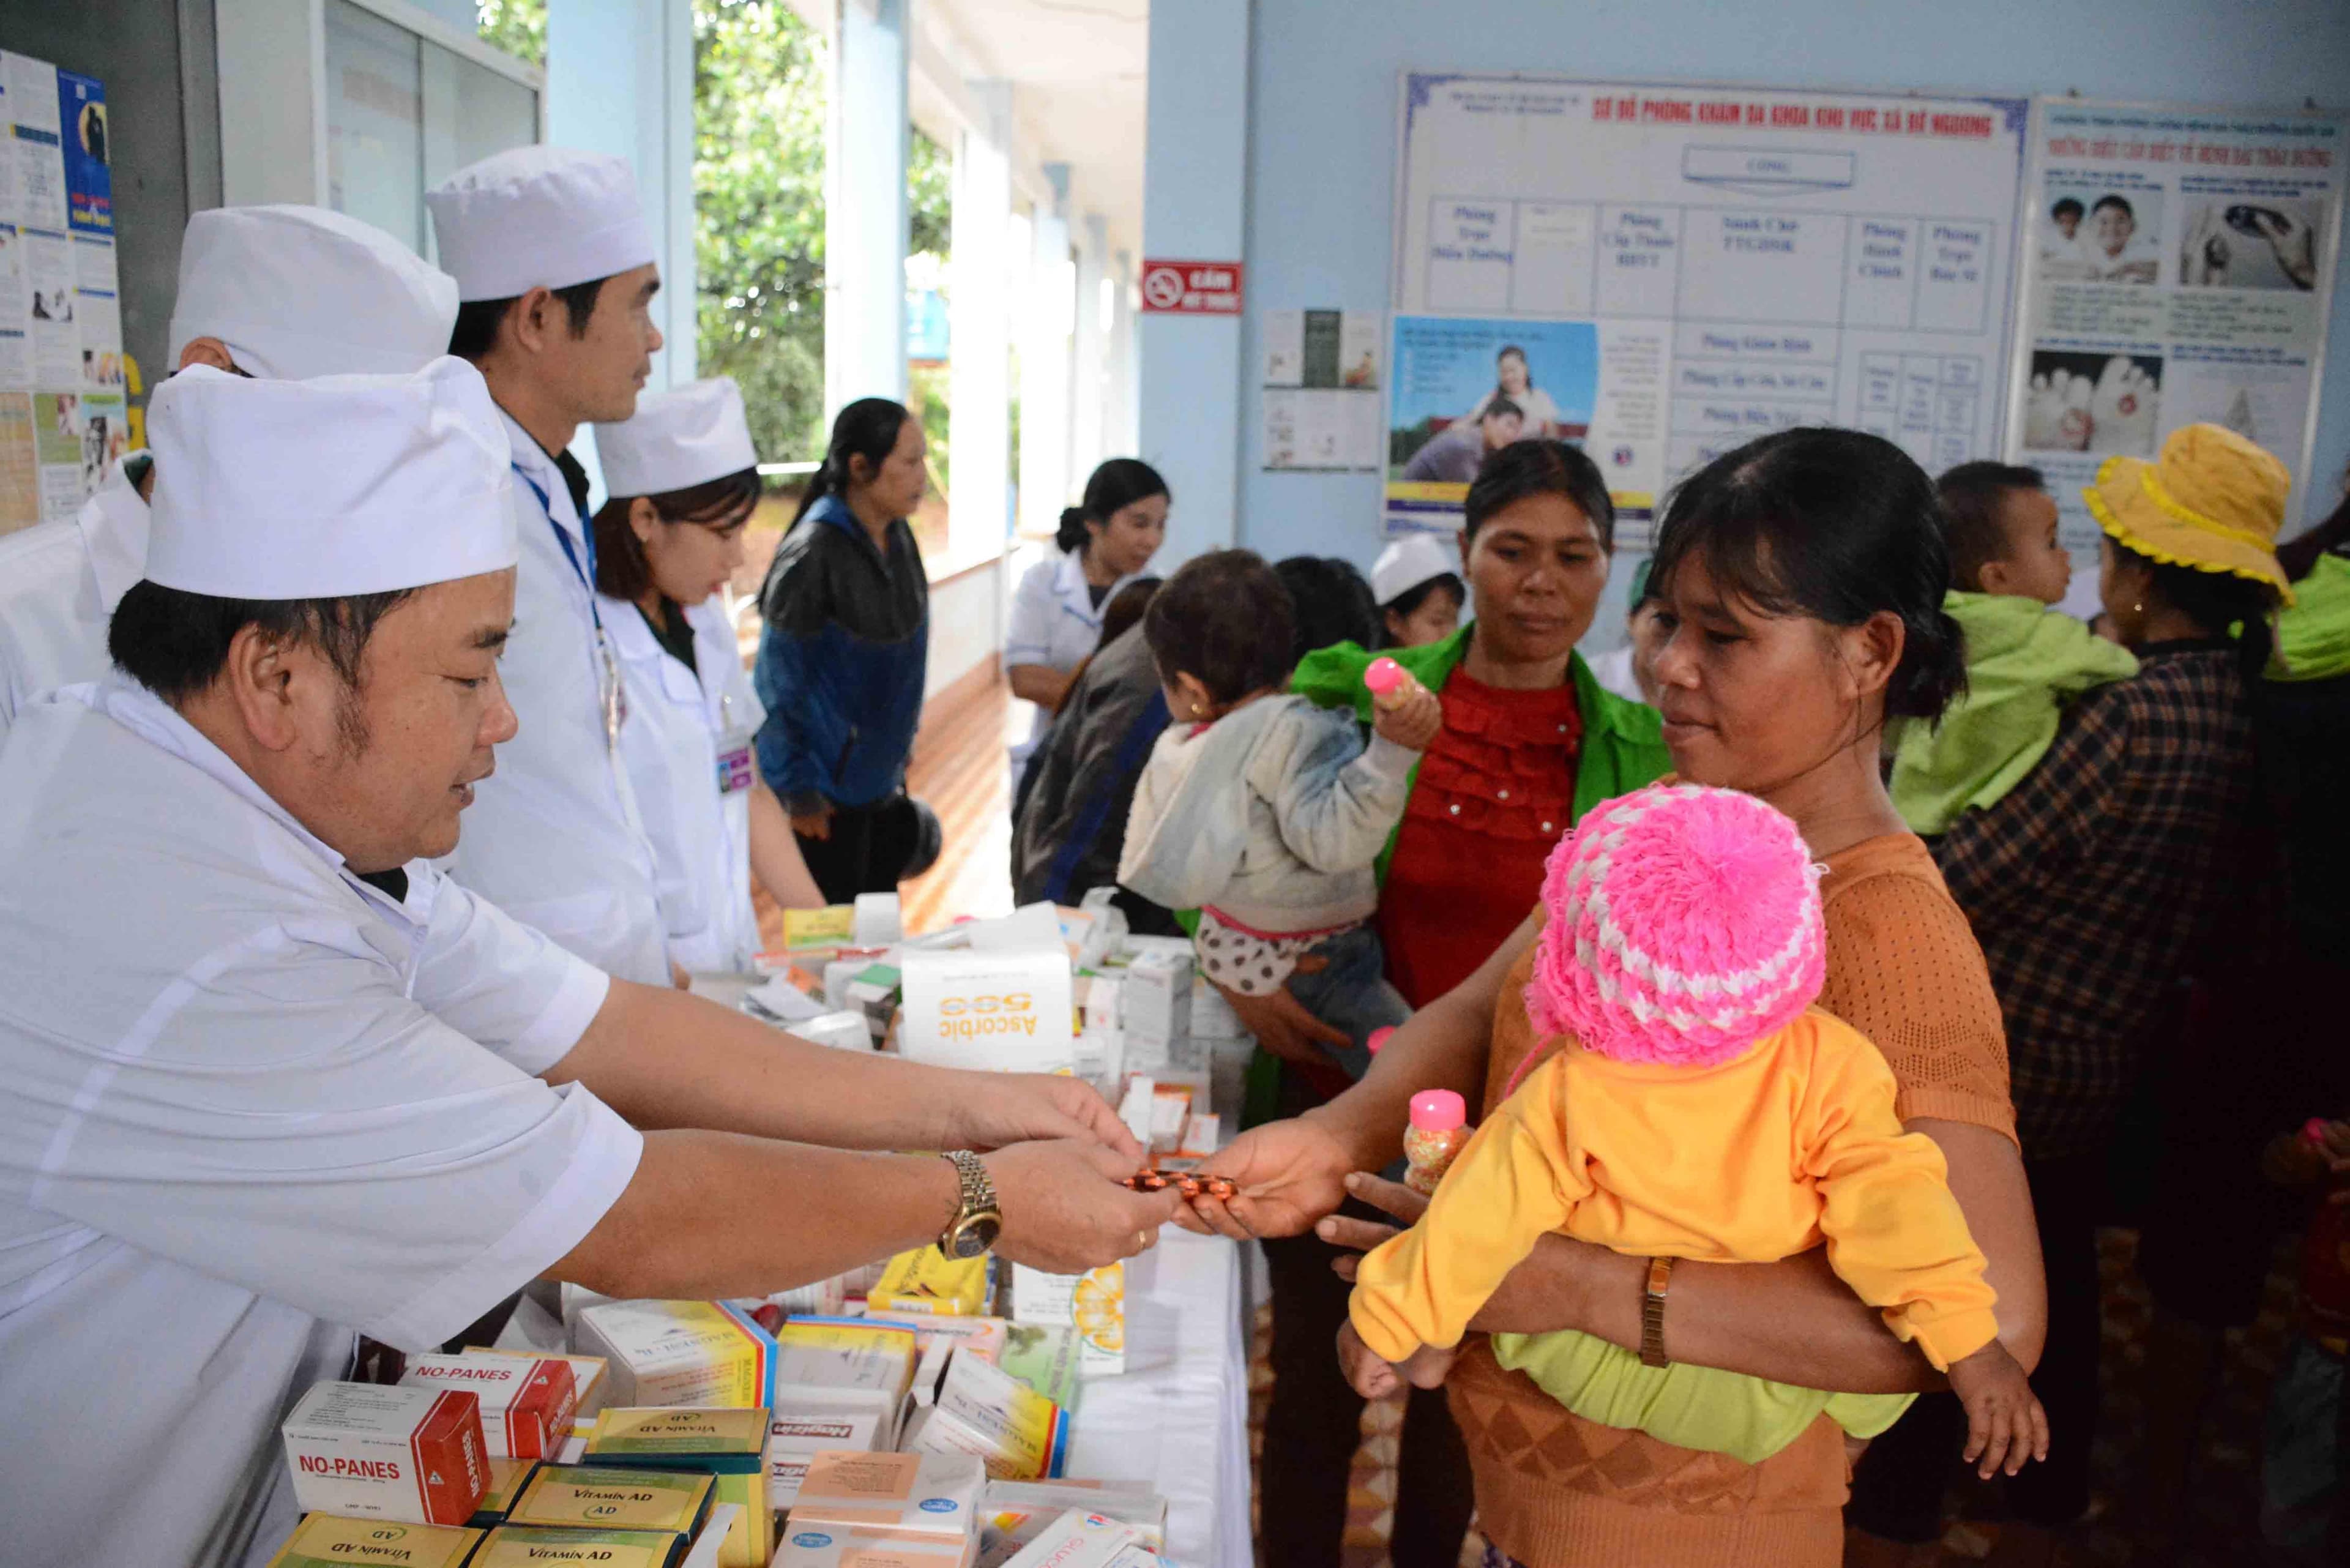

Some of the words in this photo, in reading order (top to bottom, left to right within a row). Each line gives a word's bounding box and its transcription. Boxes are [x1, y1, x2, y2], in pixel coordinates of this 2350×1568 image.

[938, 1014, 1038, 1043] Ascorbic
[416, 1366, 512, 1381] NO-PANES
[299, 1454, 401, 1480] NO-PANES
[629, 1492, 653, 1502] AD
[594, 1506, 617, 1515] AD
[331, 1542, 355, 1553] AD
[586, 1551, 613, 1561] AD
